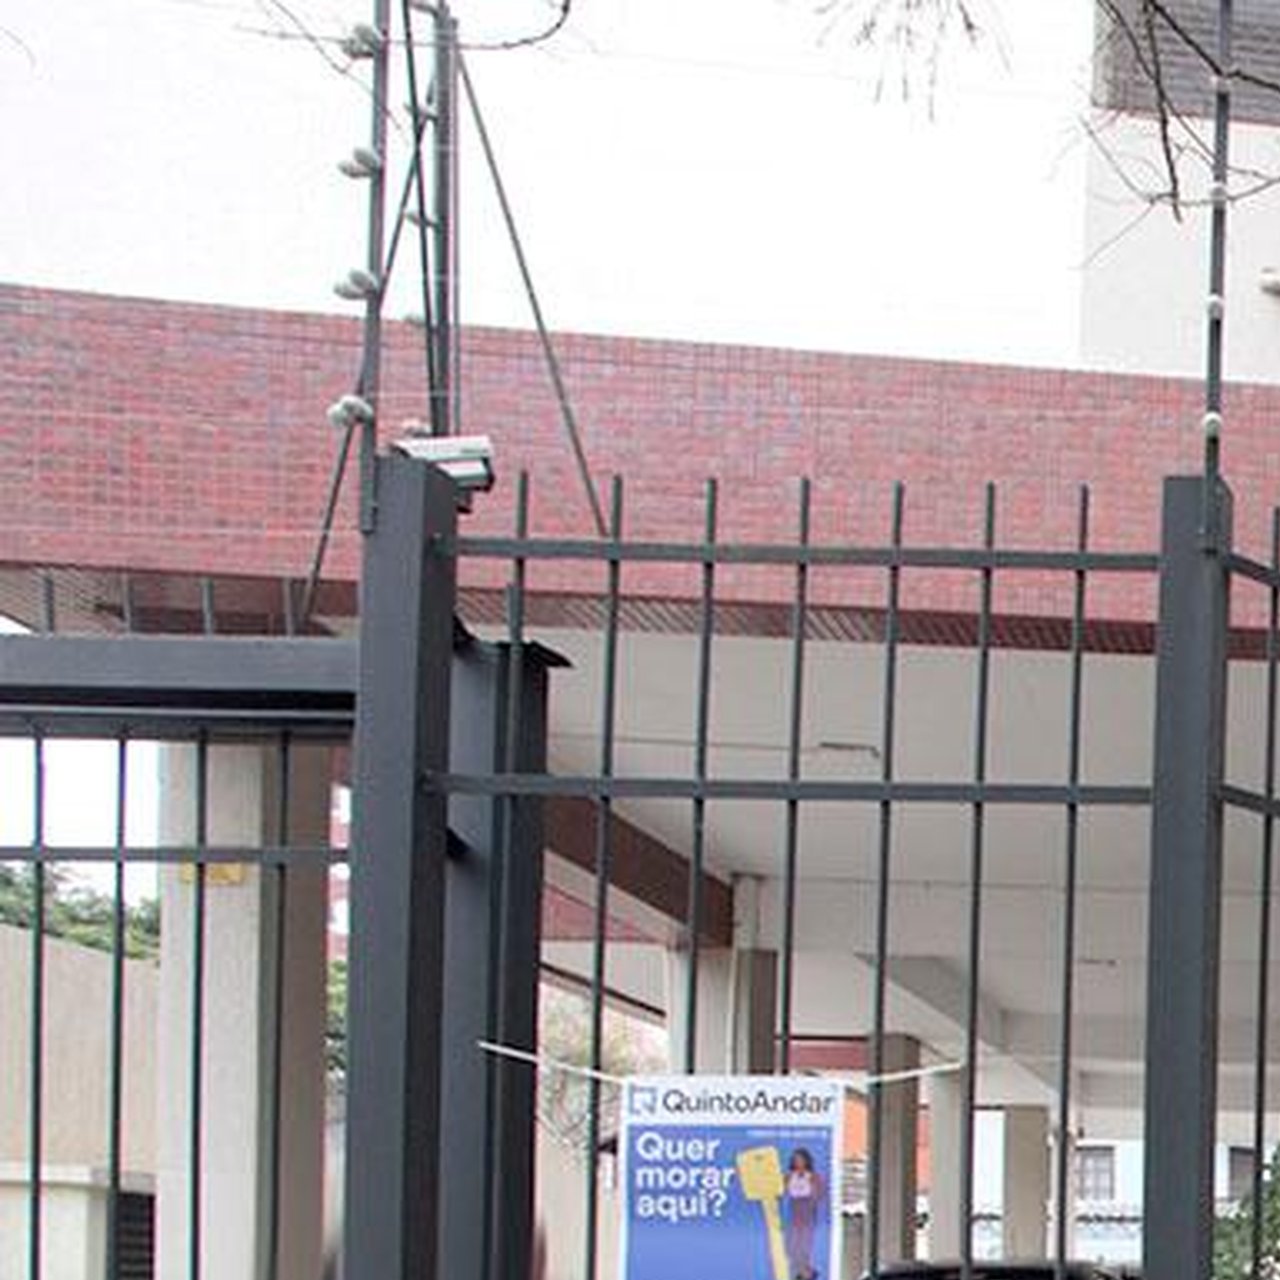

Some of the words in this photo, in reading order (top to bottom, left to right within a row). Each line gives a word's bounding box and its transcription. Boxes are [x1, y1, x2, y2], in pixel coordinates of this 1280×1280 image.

[662, 1089, 834, 1113] QuintoAndar
[636, 1132, 721, 1161] Quer
[635, 1164, 738, 1189] morar
[636, 1190, 727, 1222] aqui?
